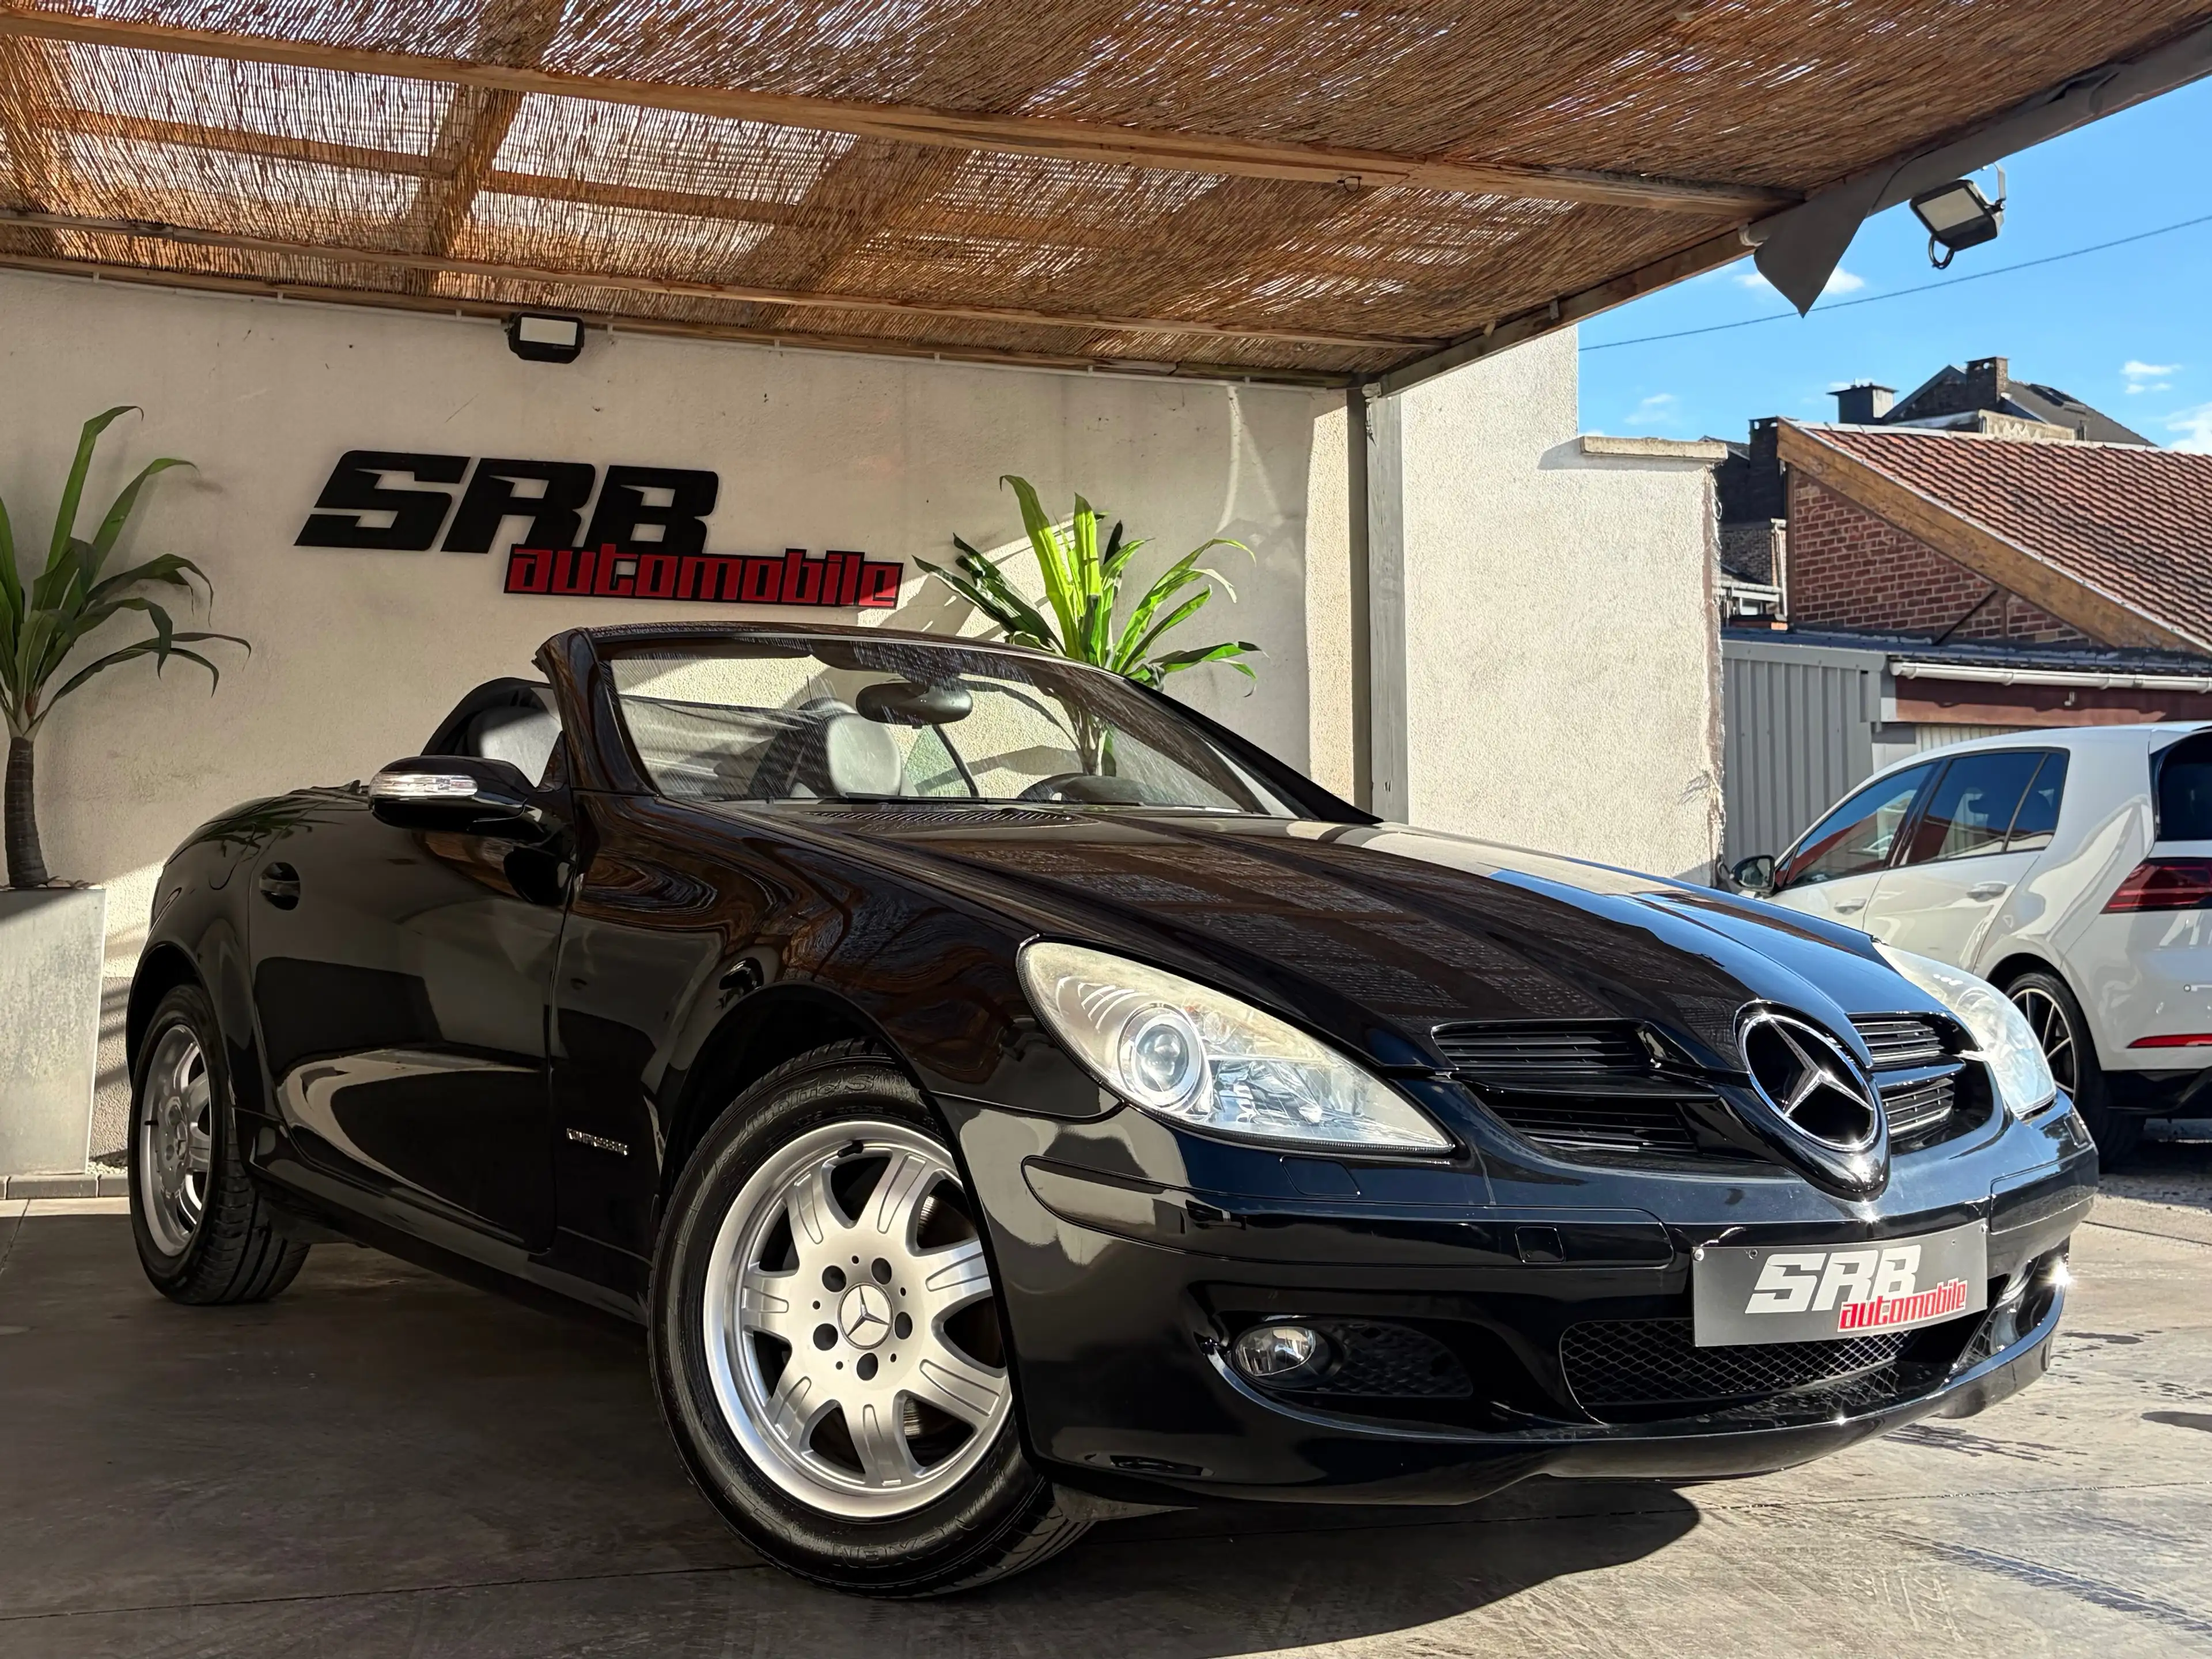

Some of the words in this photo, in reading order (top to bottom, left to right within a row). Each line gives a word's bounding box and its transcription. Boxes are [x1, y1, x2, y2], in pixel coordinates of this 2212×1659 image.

[294, 450, 719, 554] SRB
[504, 543, 904, 608] automobile
[1745, 1244, 1922, 1314] SRB
[1837, 1278, 1968, 1332] automobile
